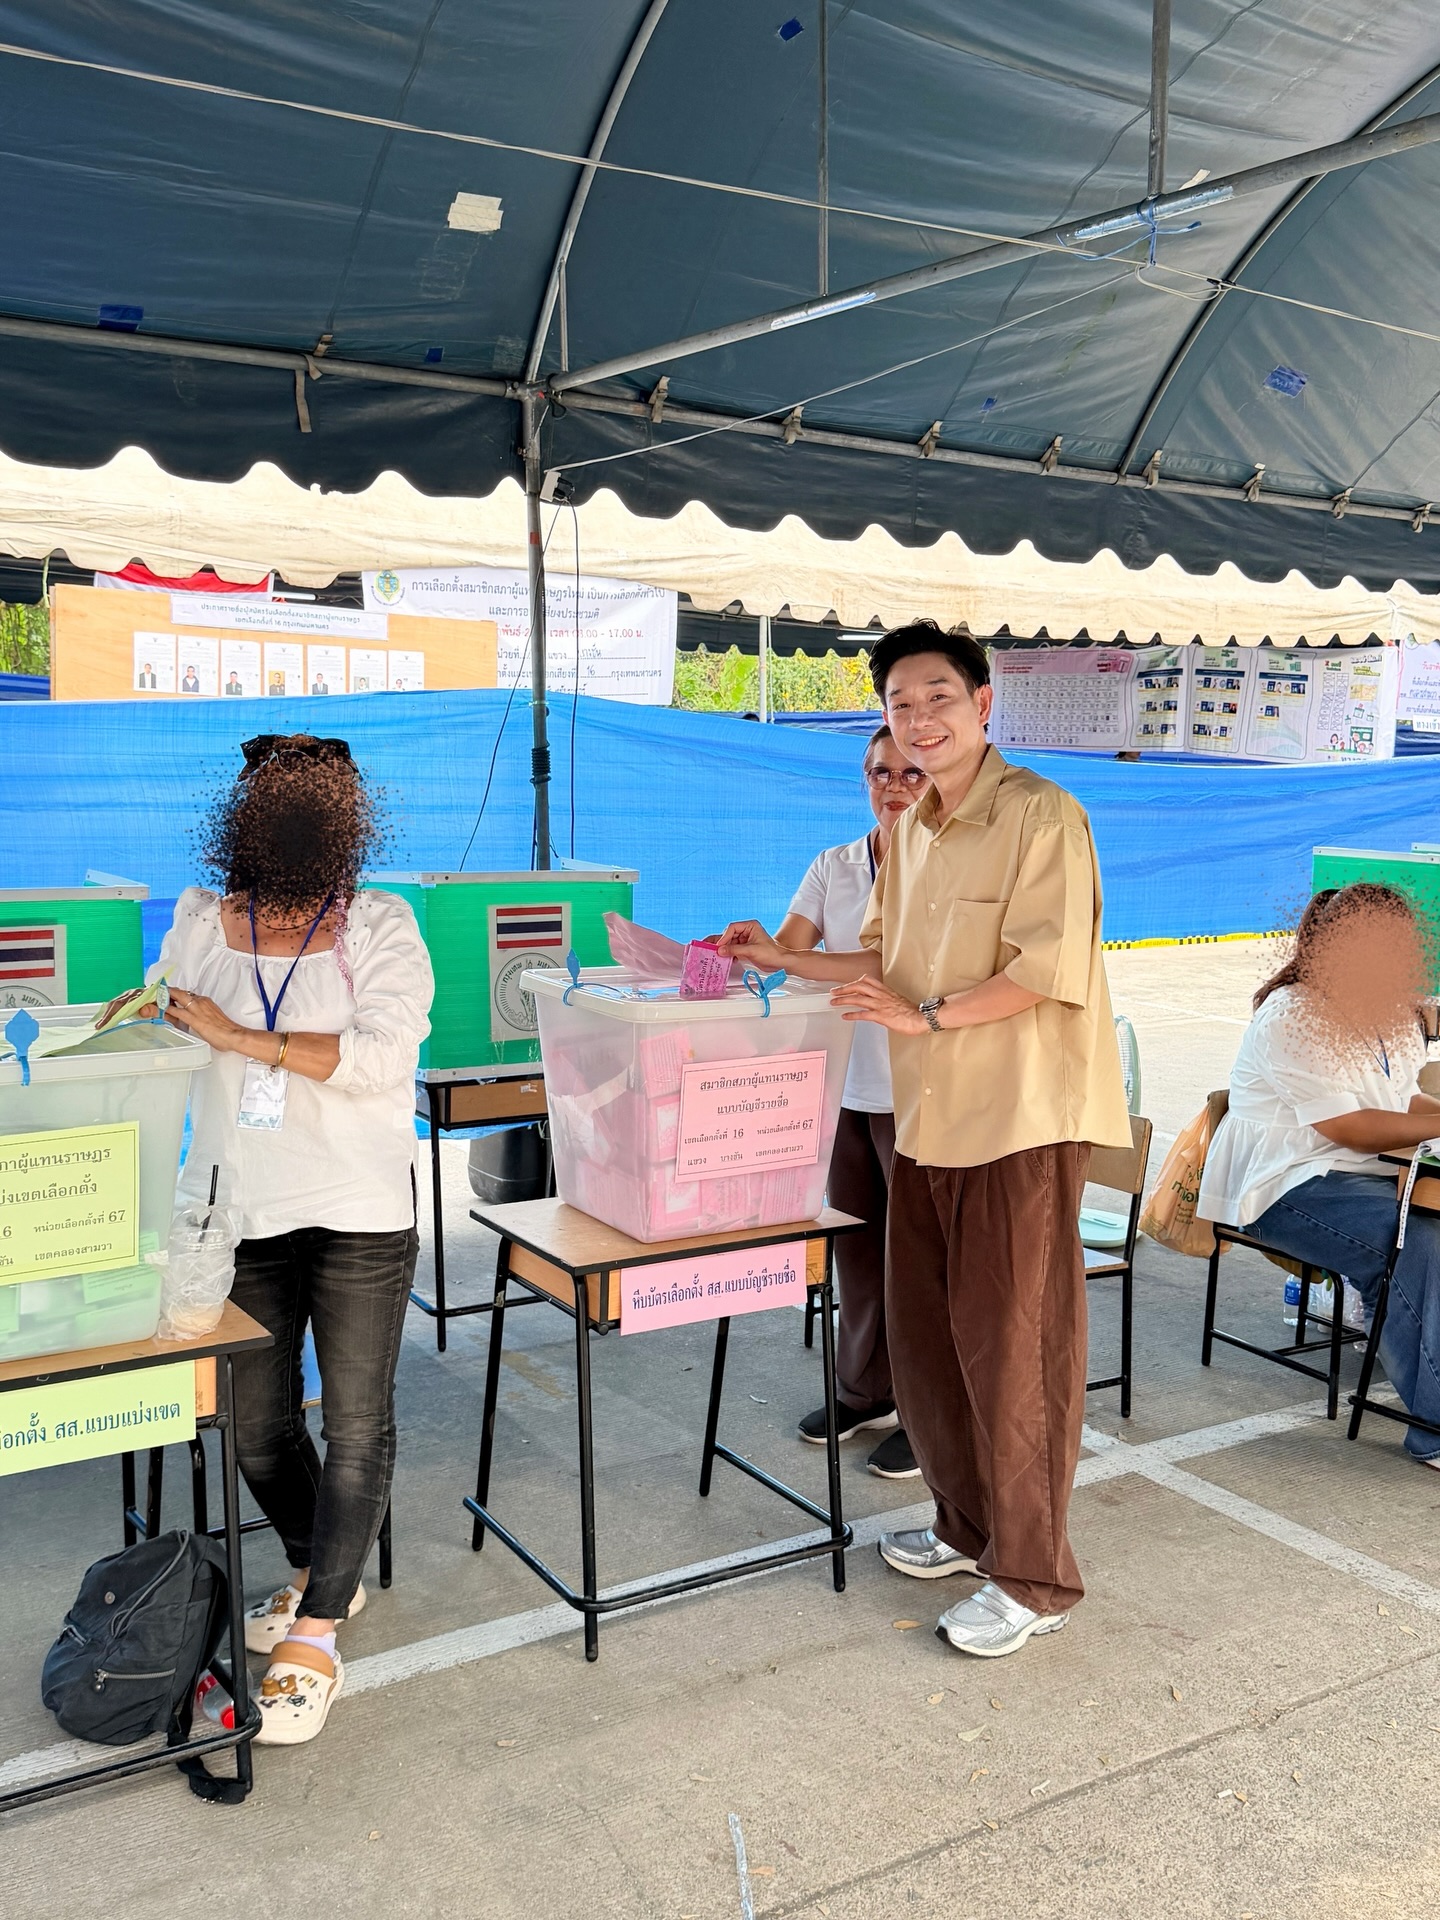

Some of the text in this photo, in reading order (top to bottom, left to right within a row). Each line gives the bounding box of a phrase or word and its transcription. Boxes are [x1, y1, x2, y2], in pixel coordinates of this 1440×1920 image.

[700, 1070, 809, 1091] สมาชิกสภาผู้แทนราษฎร
[717, 1091, 789, 1115] แบบบัญชีรายชื่อ
[684, 1119, 814, 1145] เขตเลือกตั้งที่ 16 หน่วยเลือกตั้งที่ 67
[687, 1144, 804, 1166] แขวง บางชัน เขตคลองสามวา
[0, 1210, 126, 1238] 6 หน่วยเลือกตั้งที่ 67
[35, 1242, 112, 1261] เขตคลองสามวา
[632, 1259, 796, 1310] หีบบัตรเลือกตั้ง สส.แบบบัญชีรายชื่อ
[55, 1401, 181, 1439] สส.แบบแบ่งเขต
